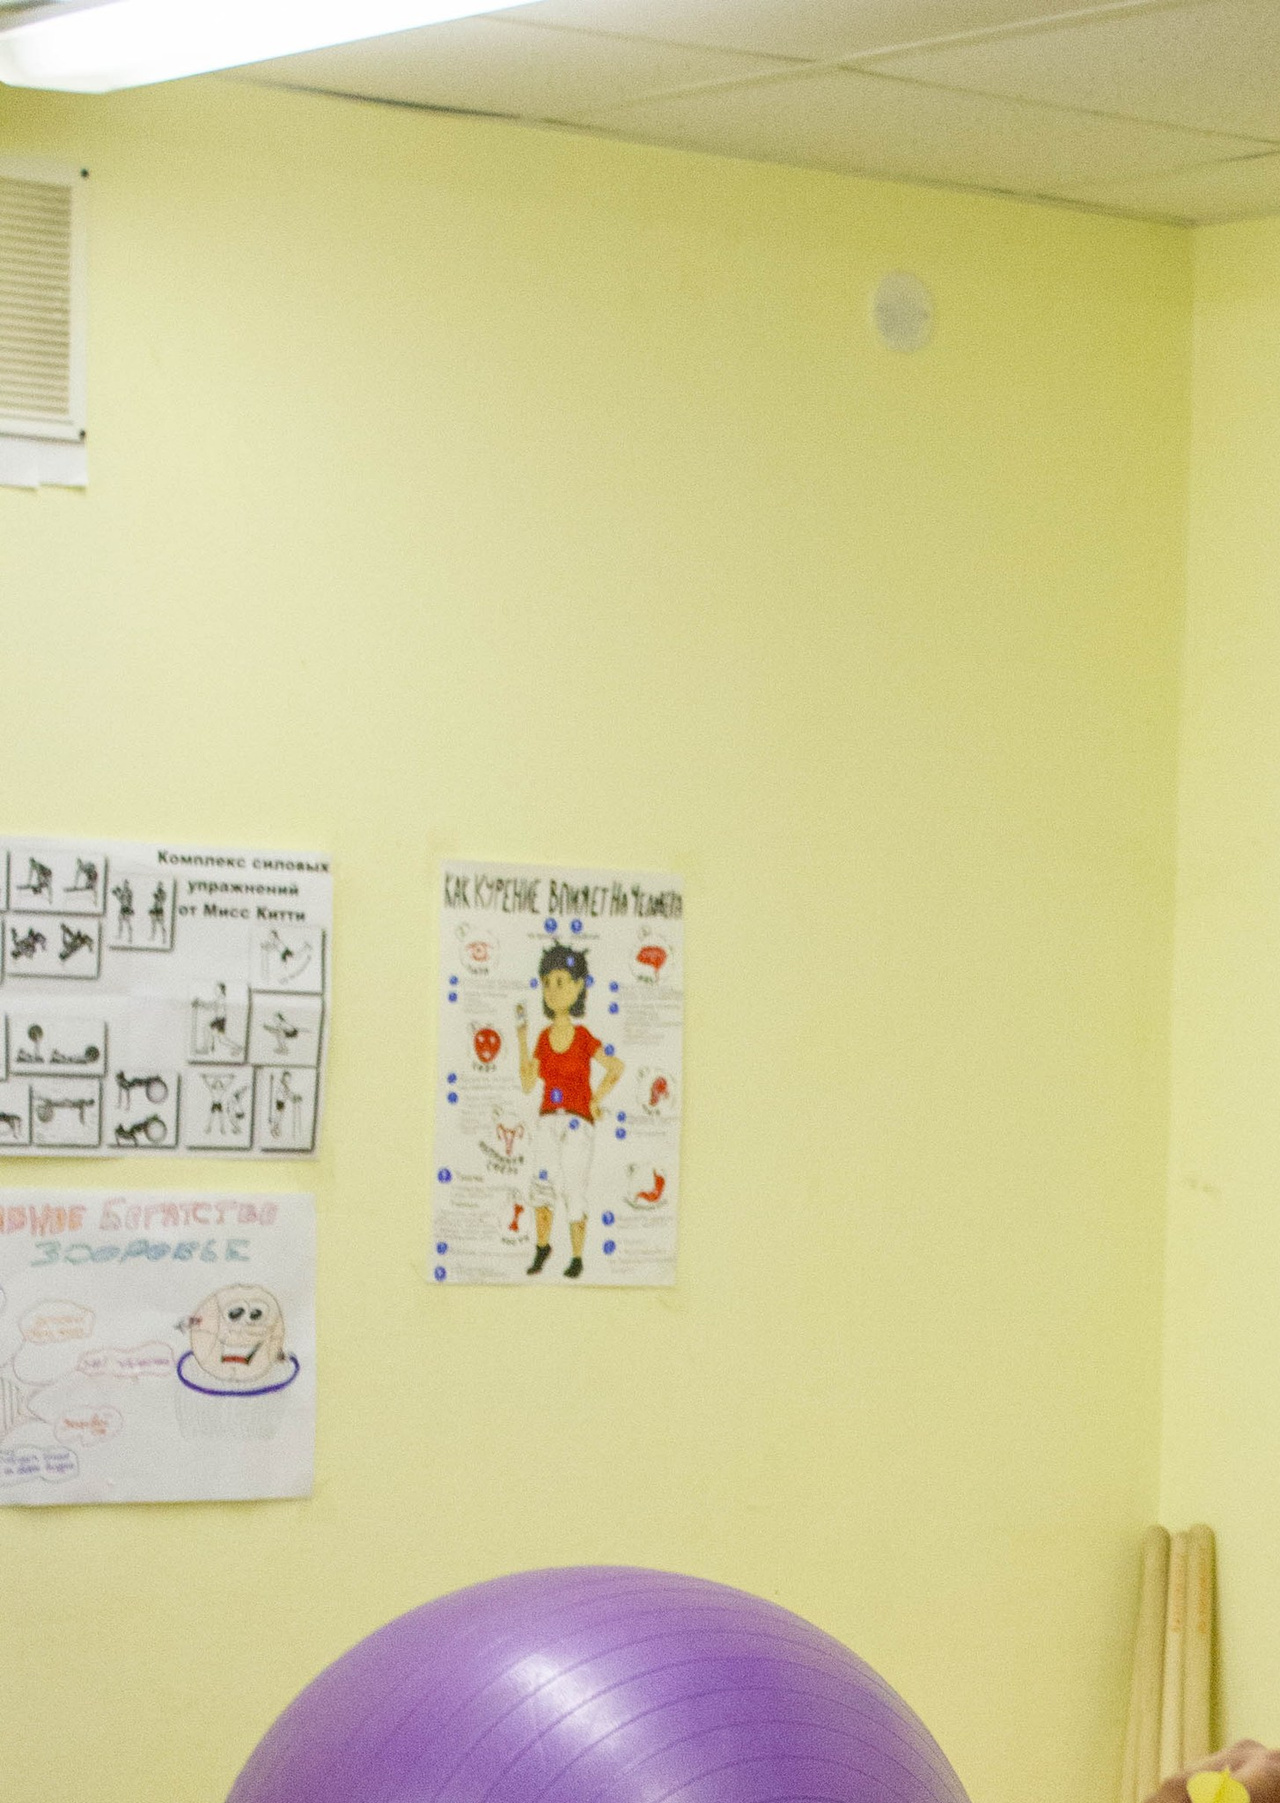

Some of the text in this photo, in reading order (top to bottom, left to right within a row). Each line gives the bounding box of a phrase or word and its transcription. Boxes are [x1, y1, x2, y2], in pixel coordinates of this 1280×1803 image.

[158, 850, 329, 873] Комплекс силовых
[188, 880, 299, 895] упражнений
[178, 903, 306, 921] от Мисс Китти
